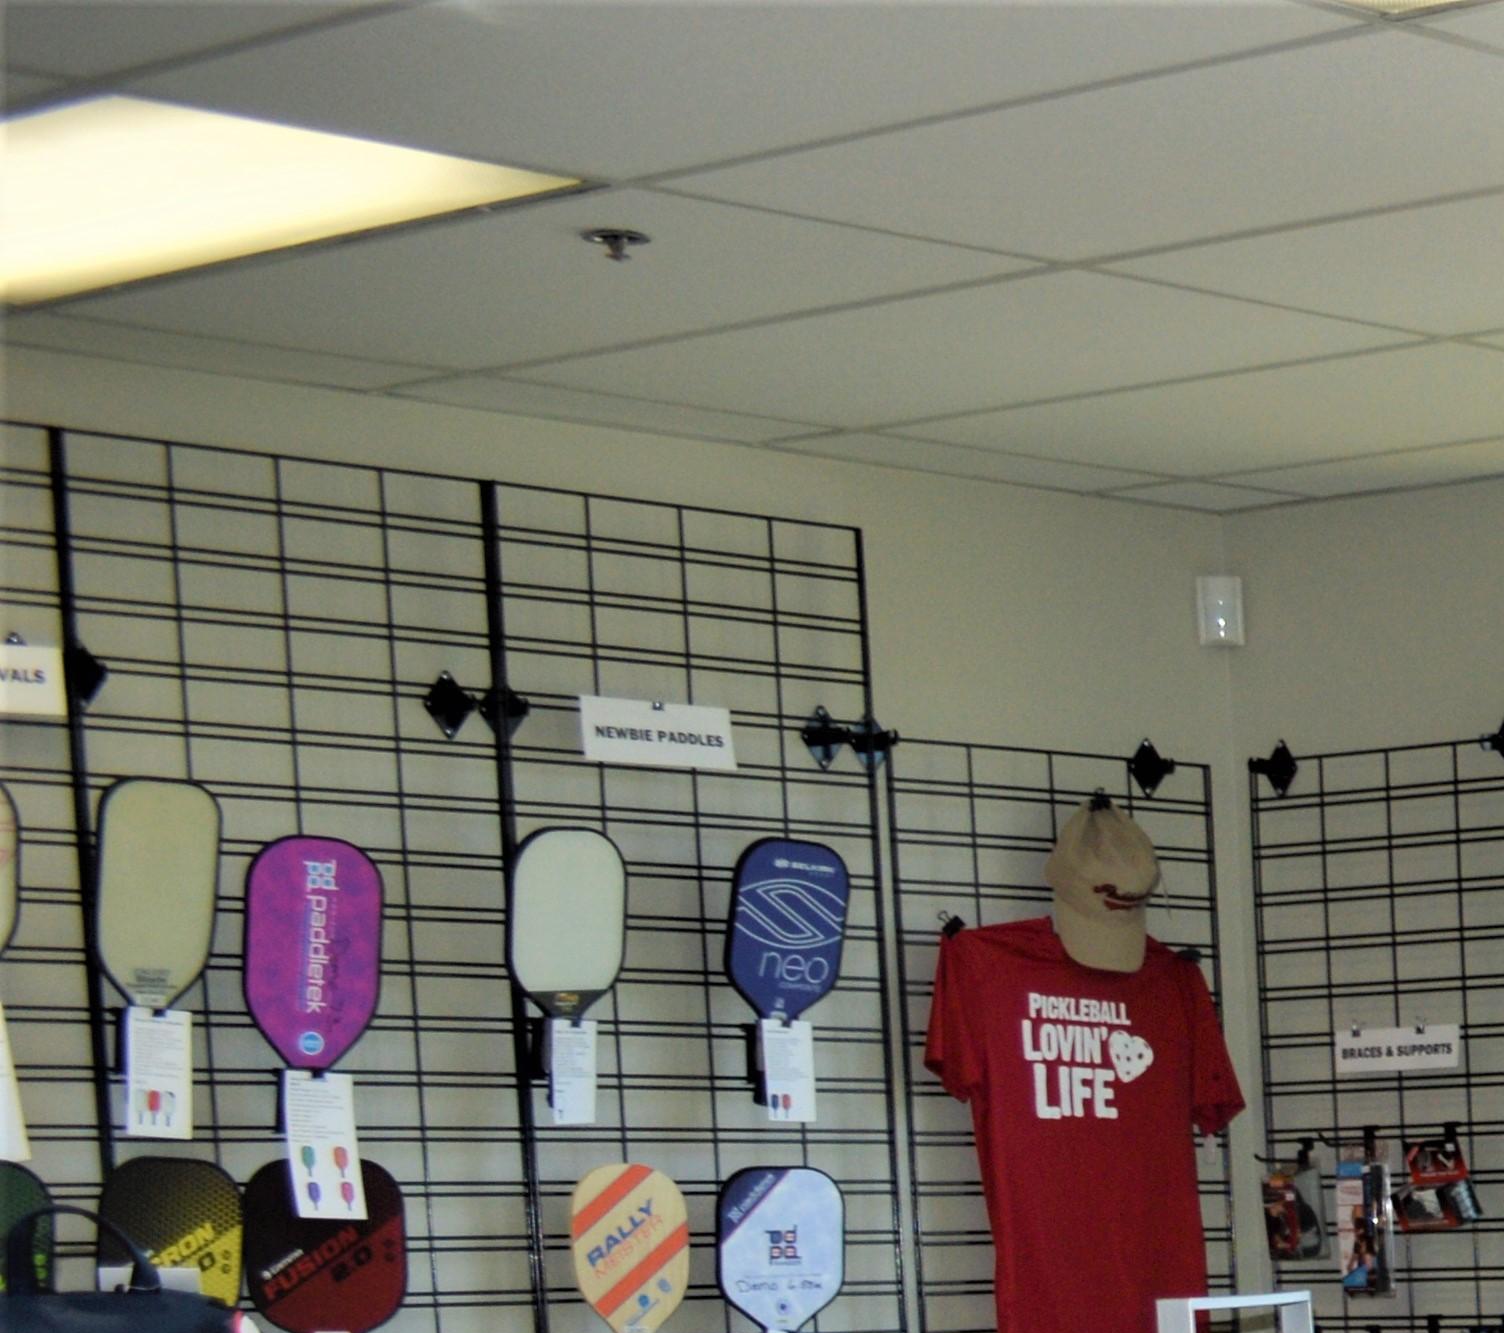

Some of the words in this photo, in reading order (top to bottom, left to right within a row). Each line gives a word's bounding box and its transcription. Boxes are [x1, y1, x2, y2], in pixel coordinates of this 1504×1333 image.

[595, 726, 653, 741] NEWBIE
[657, 730, 724, 748] PADDLES
[305, 895, 331, 1013] paddletek
[758, 952, 829, 984] neo
[1028, 991, 1132, 1026] PICKLEBALL
[1021, 1018, 1108, 1064] LOVIN'
[1342, 1046, 1382, 1060] BRACES
[1385, 1046, 1393, 1057] &
[1396, 1042, 1453, 1057] SUPPORTS
[1033, 1062, 1119, 1120] LIFE
[587, 1197, 654, 1268] RALLY
[263, 1226, 359, 1300] FUSION
